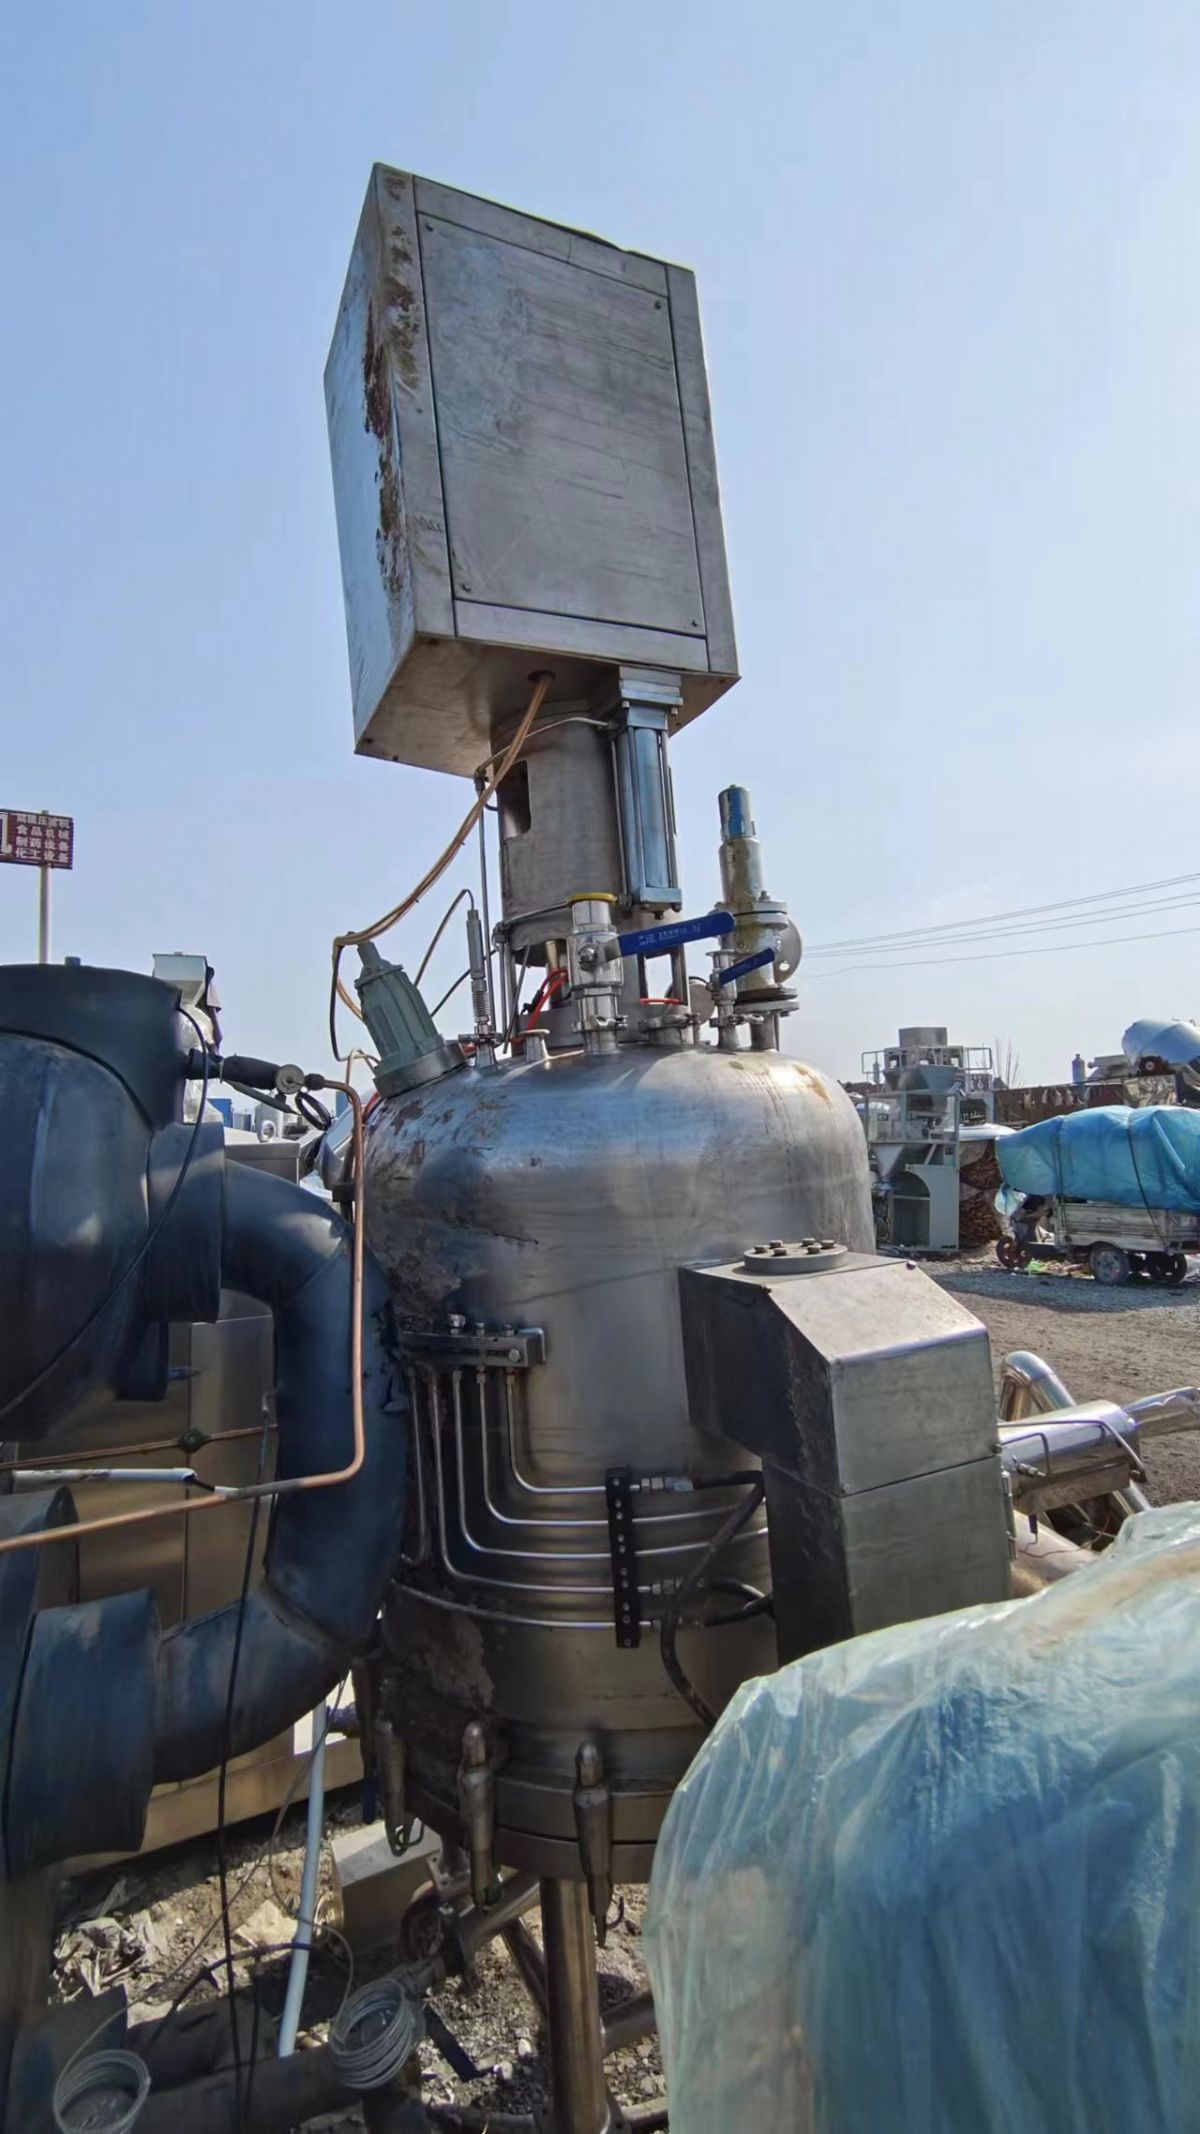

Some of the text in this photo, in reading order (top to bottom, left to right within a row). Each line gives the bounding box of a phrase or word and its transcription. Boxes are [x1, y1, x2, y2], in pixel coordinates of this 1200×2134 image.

[17, 825, 69, 840] 食品机械
[16, 836, 69, 851] 制药设备
[15, 847, 69, 863] 化工设备
